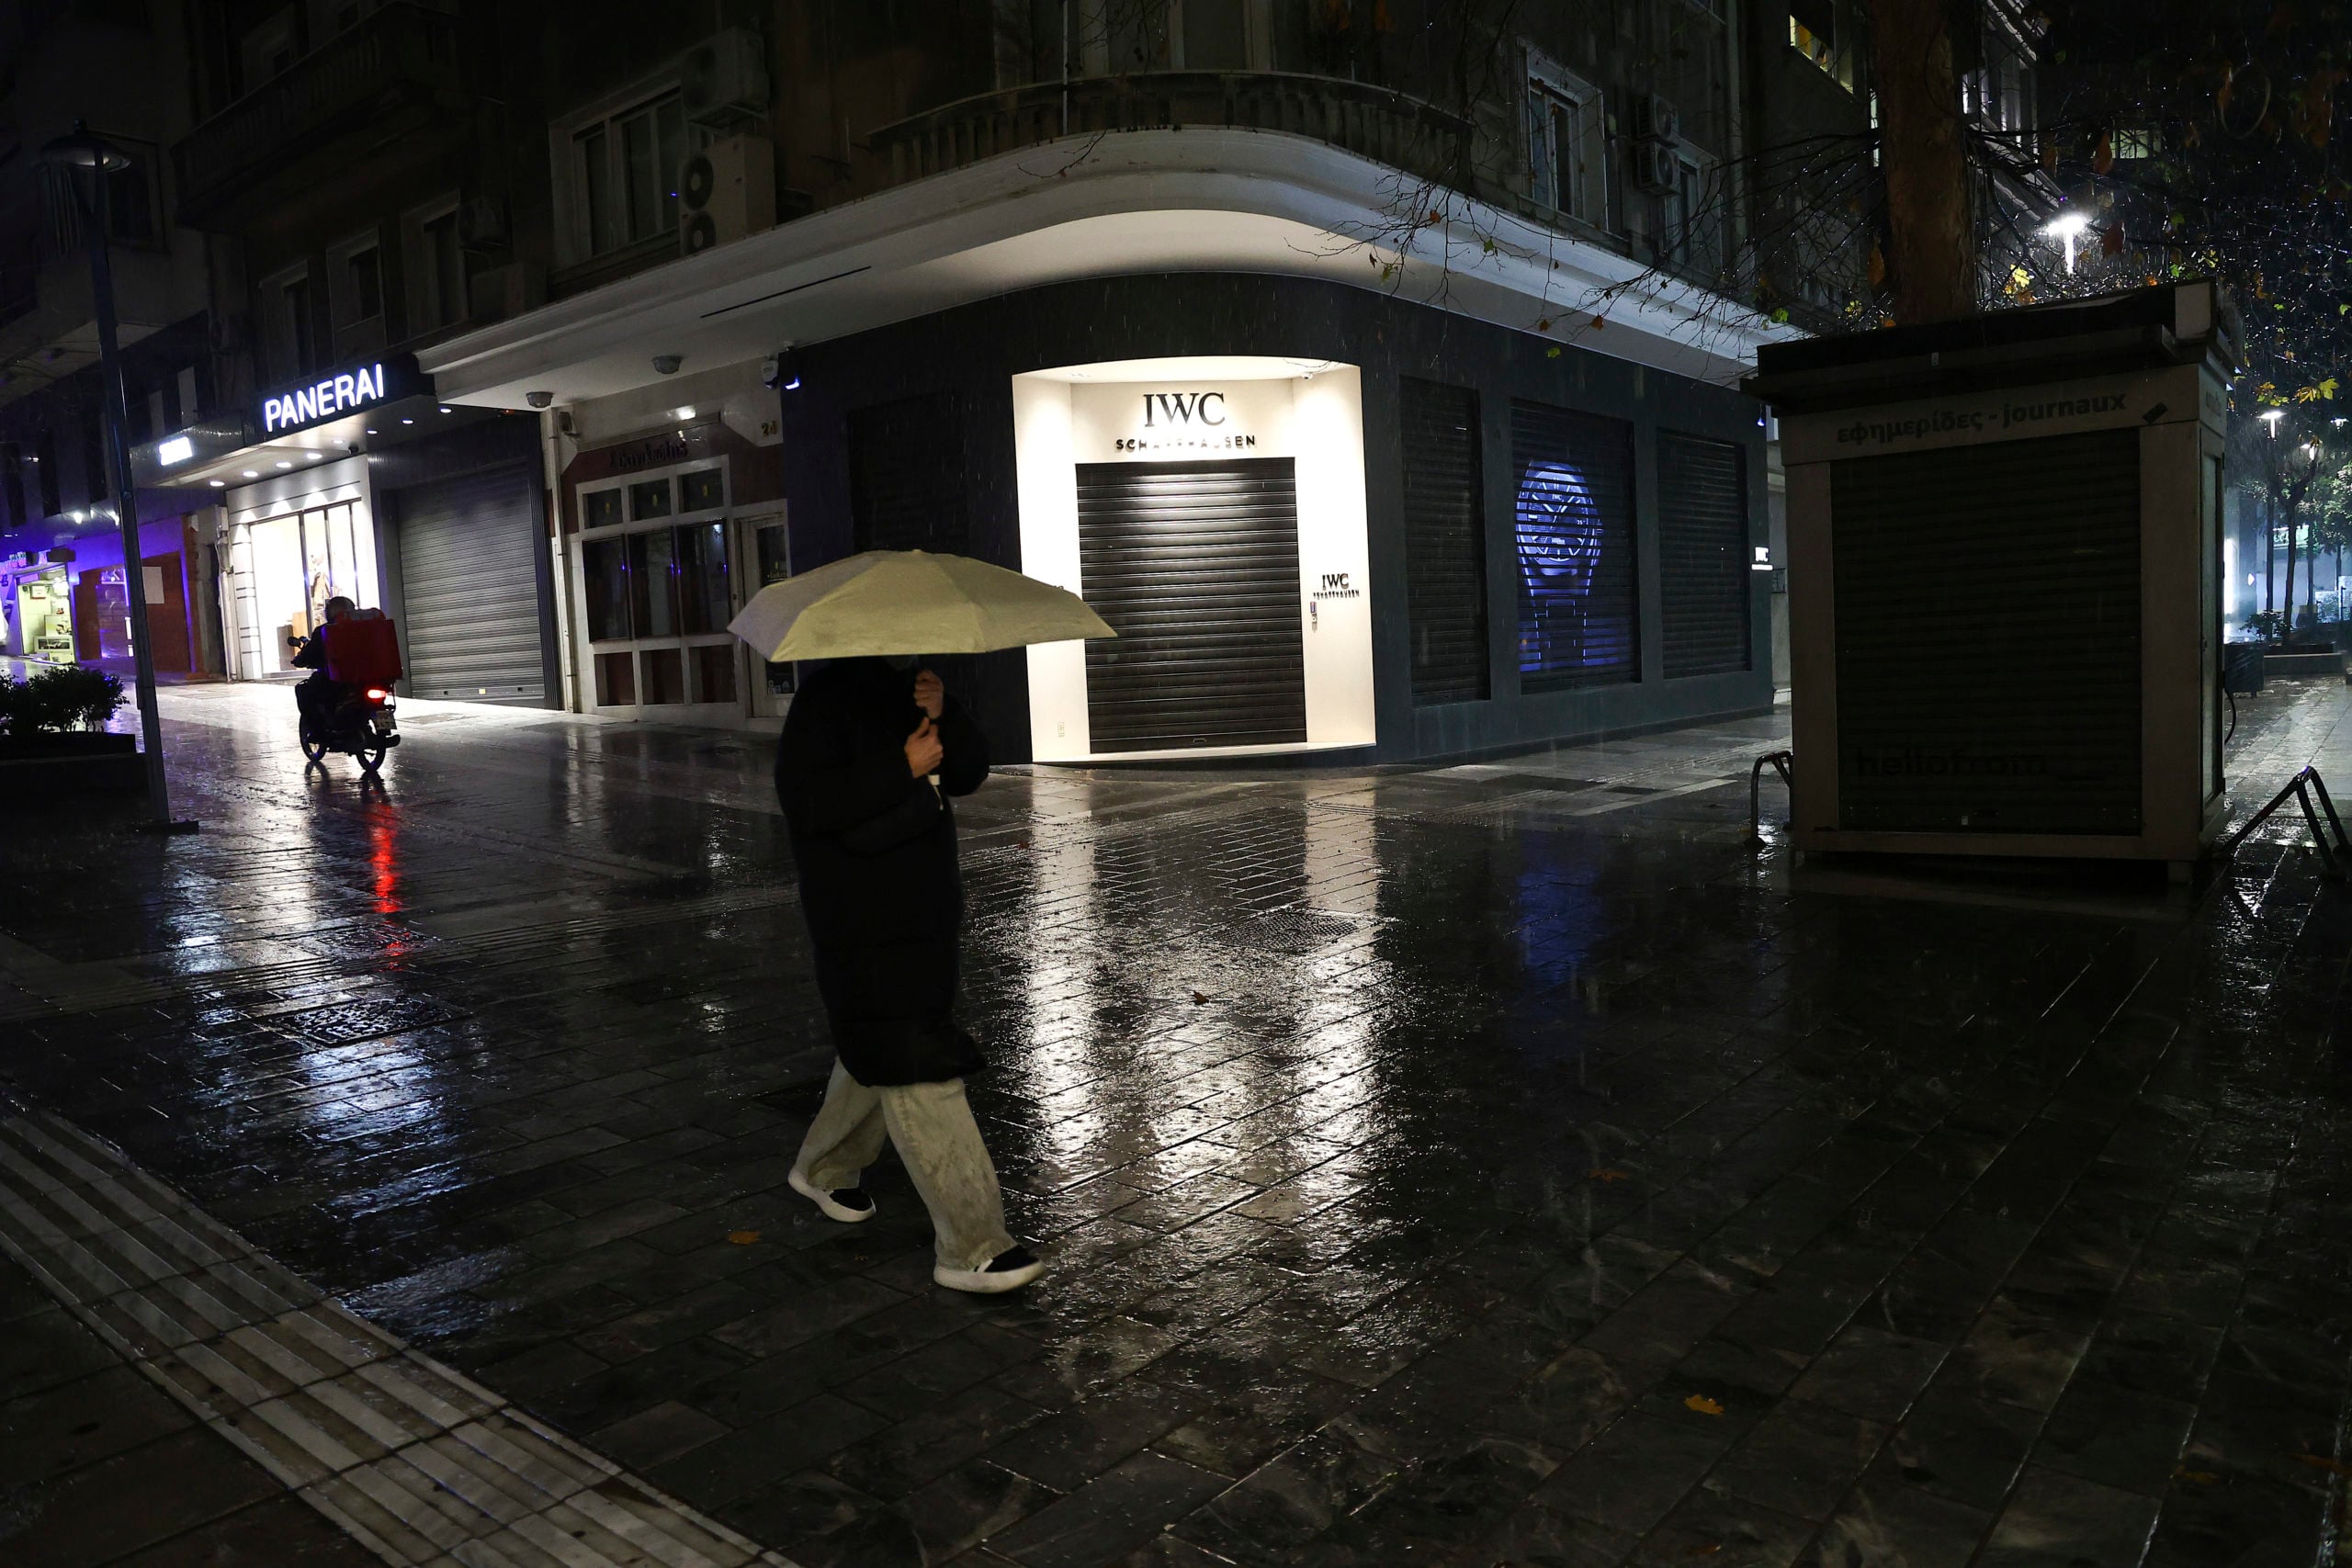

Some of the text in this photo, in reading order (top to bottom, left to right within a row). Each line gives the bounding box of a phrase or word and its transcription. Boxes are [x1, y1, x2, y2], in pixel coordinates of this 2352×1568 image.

[264, 363, 384, 433] PANERAI
[1142, 391, 1227, 428] IWC
[1838, 409, 1984, 446] εφημερίδες
[2002, 393, 2127, 429] journaux
[1321, 573, 1350, 591] IWC
